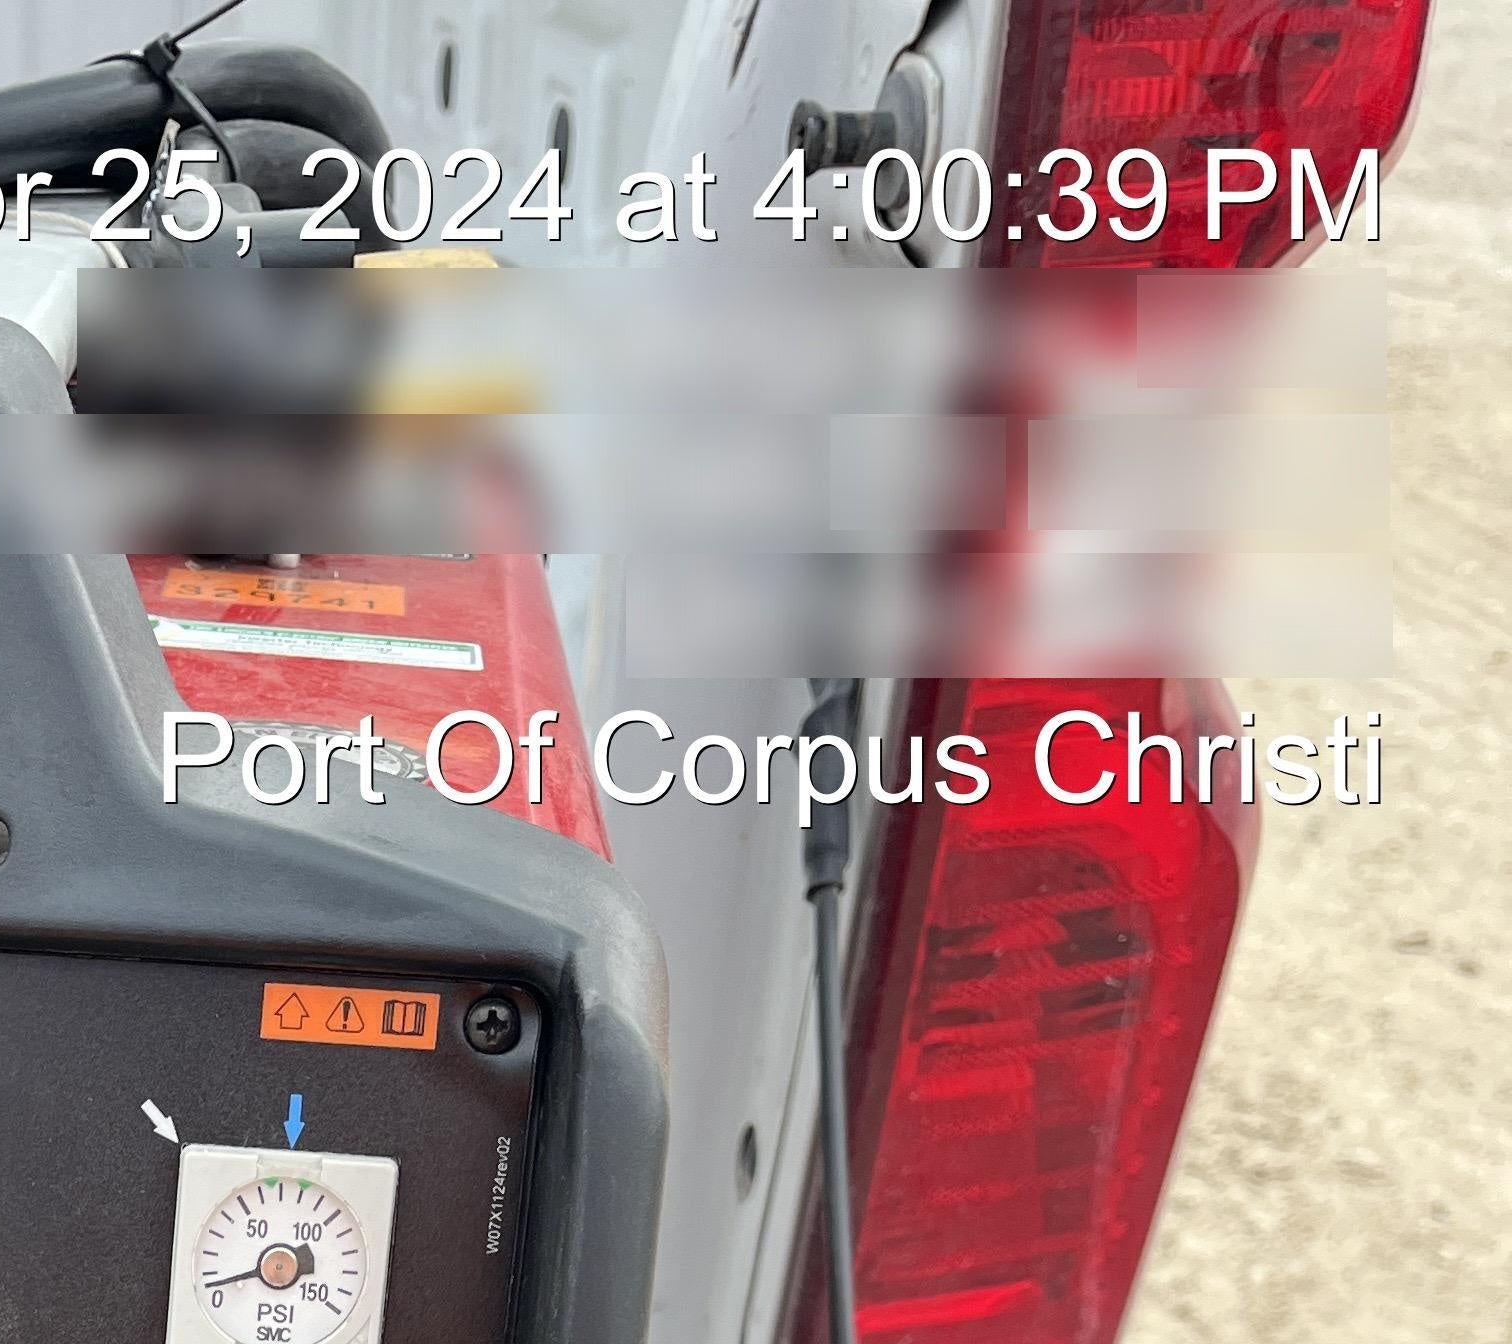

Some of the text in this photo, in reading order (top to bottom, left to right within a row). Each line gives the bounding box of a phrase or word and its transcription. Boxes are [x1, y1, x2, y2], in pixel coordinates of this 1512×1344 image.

[485, 1136, 511, 1255] W07X1124rev02
[246, 1218, 323, 1243] 50 100
[211, 1281, 329, 1309] 0 150
[257, 1303, 294, 1324] PSI
[256, 1326, 291, 1343] SMC
